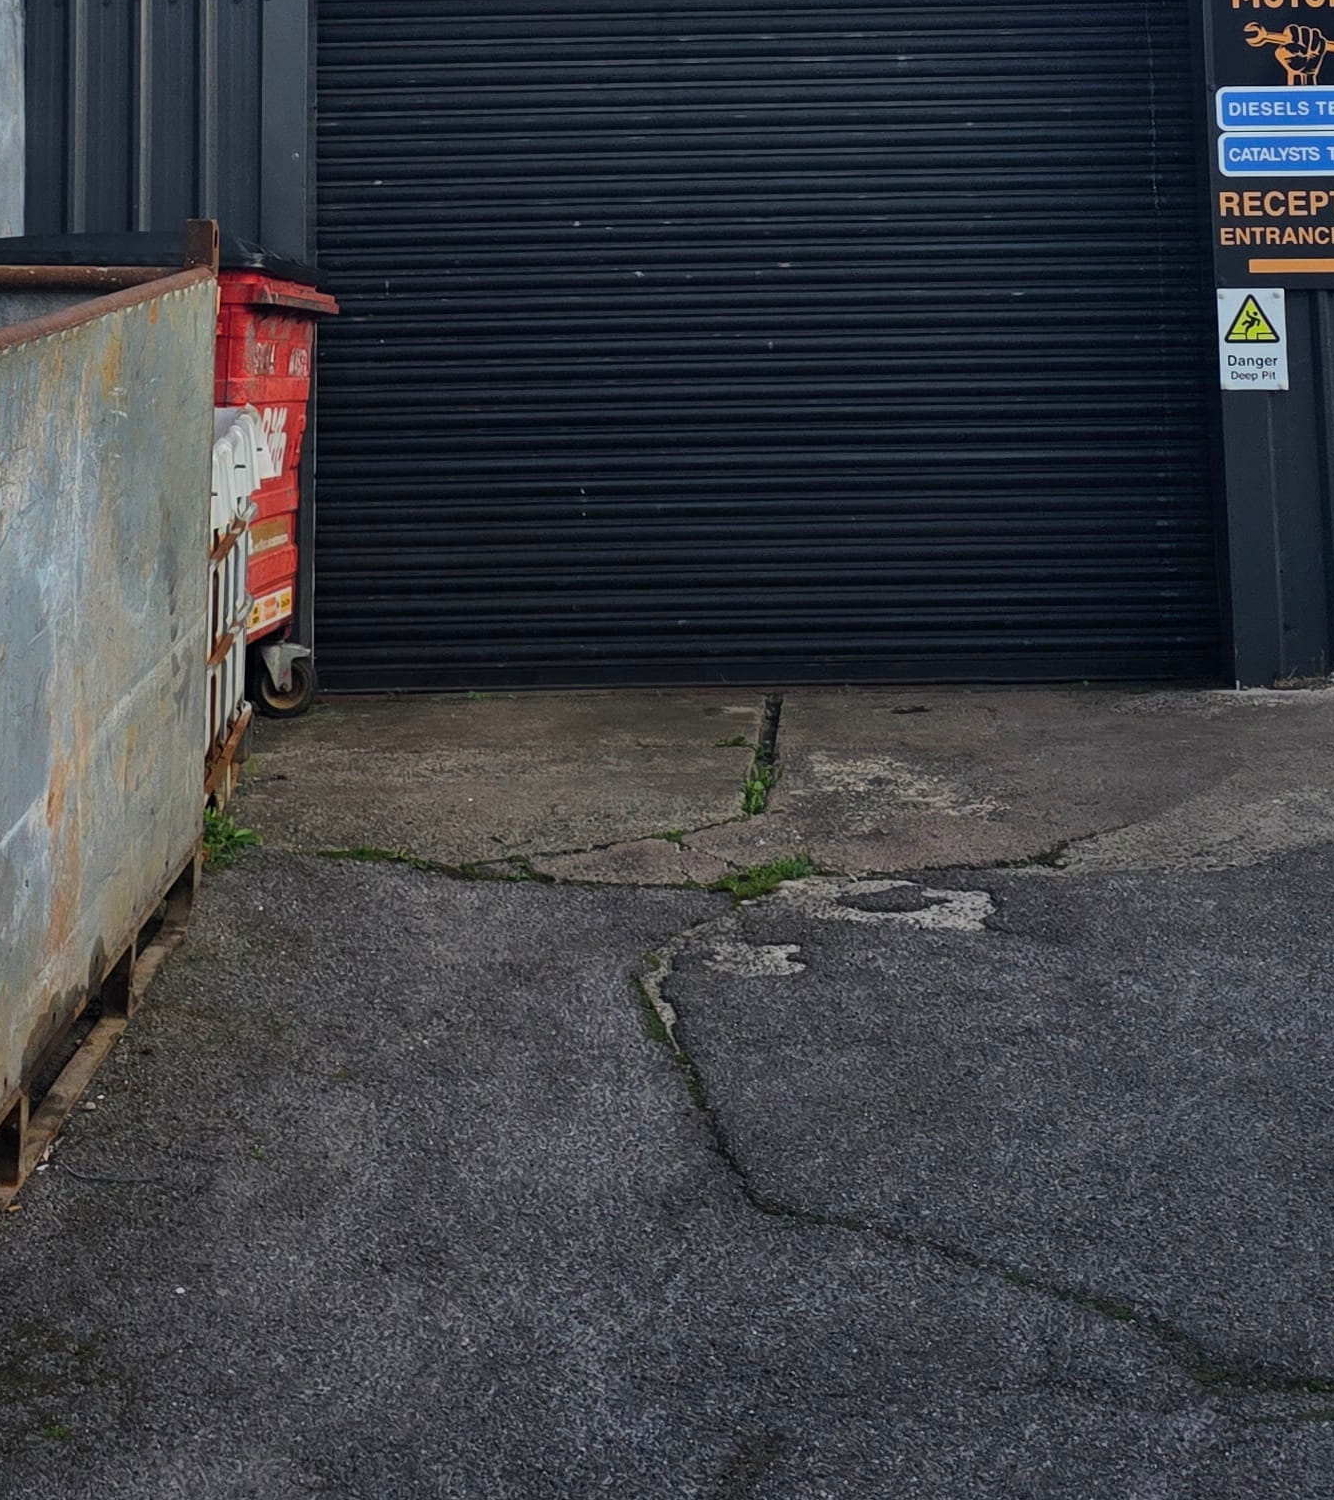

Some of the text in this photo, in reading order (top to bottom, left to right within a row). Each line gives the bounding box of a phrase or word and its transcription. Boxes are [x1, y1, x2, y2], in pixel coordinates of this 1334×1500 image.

[1228, 101, 1309, 117] DIESELS
[1228, 147, 1321, 162] CATALYSTS
[1227, 355, 1278, 370] Danger
[1230, 371, 1277, 382] Deep Pit
